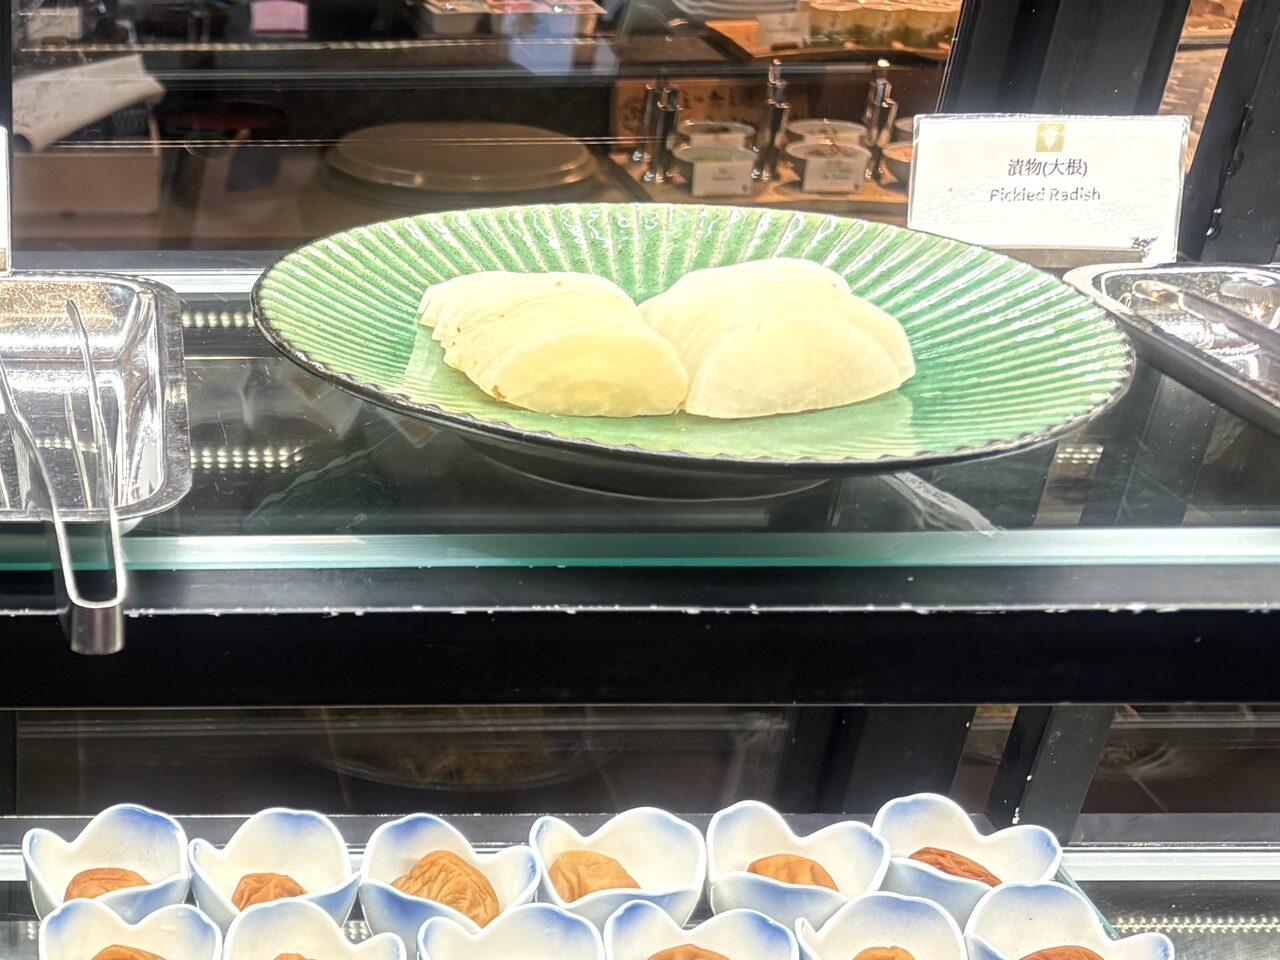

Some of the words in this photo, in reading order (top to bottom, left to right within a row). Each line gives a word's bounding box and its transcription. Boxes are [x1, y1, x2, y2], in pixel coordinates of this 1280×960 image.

[1007, 158, 1088, 178] 漬物(大根)
[1049, 187, 1101, 201] Radish
